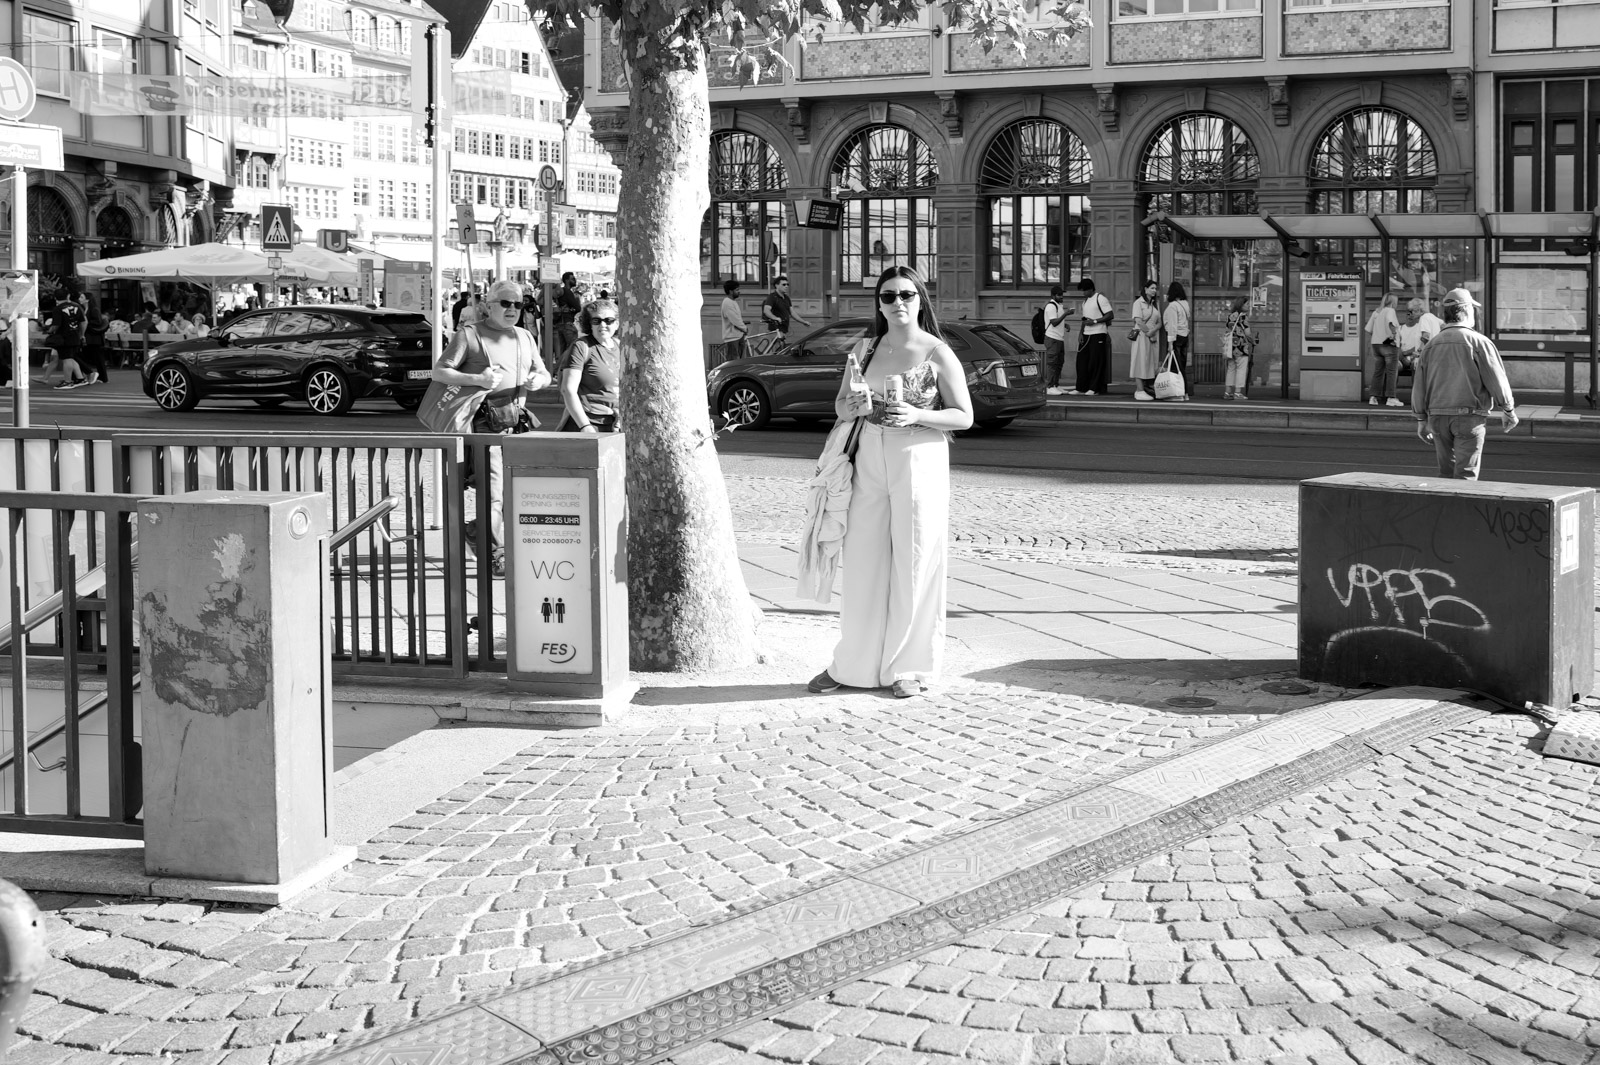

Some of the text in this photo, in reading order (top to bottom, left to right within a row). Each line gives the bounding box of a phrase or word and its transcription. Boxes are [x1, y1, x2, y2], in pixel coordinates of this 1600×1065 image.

[326, 231, 345, 251] U
[117, 266, 146, 274] BINDING
[1307, 288, 1337, 297] TICKETS
[544, 516, 563, 524] 23:45
[522, 529, 581, 537] SERVICETELEFON
[530, 559, 575, 581] WC
[540, 642, 569, 656] FES
